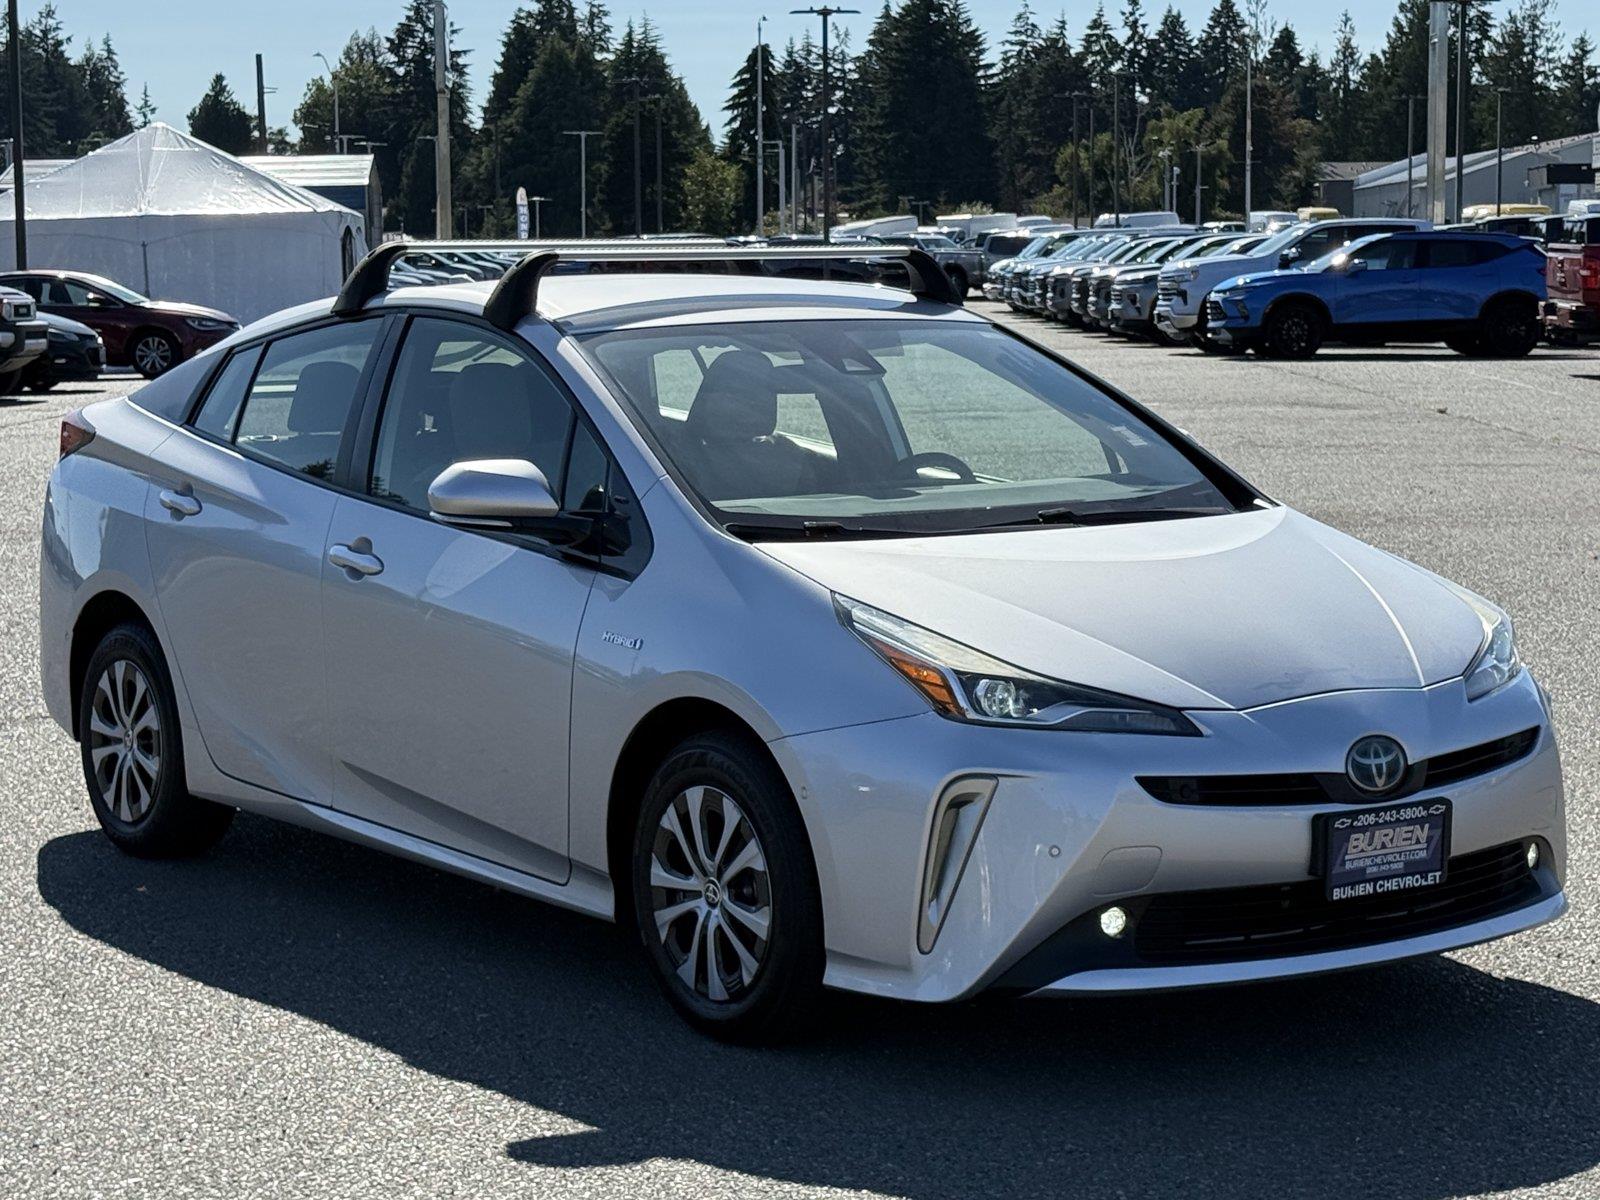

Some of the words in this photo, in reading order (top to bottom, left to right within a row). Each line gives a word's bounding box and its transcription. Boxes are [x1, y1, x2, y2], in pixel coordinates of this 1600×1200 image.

[519, 205, 529, 240] HOND
[1357, 806, 1424, 826] 206-243-5800
[1347, 823, 1430, 854] BURIEN
